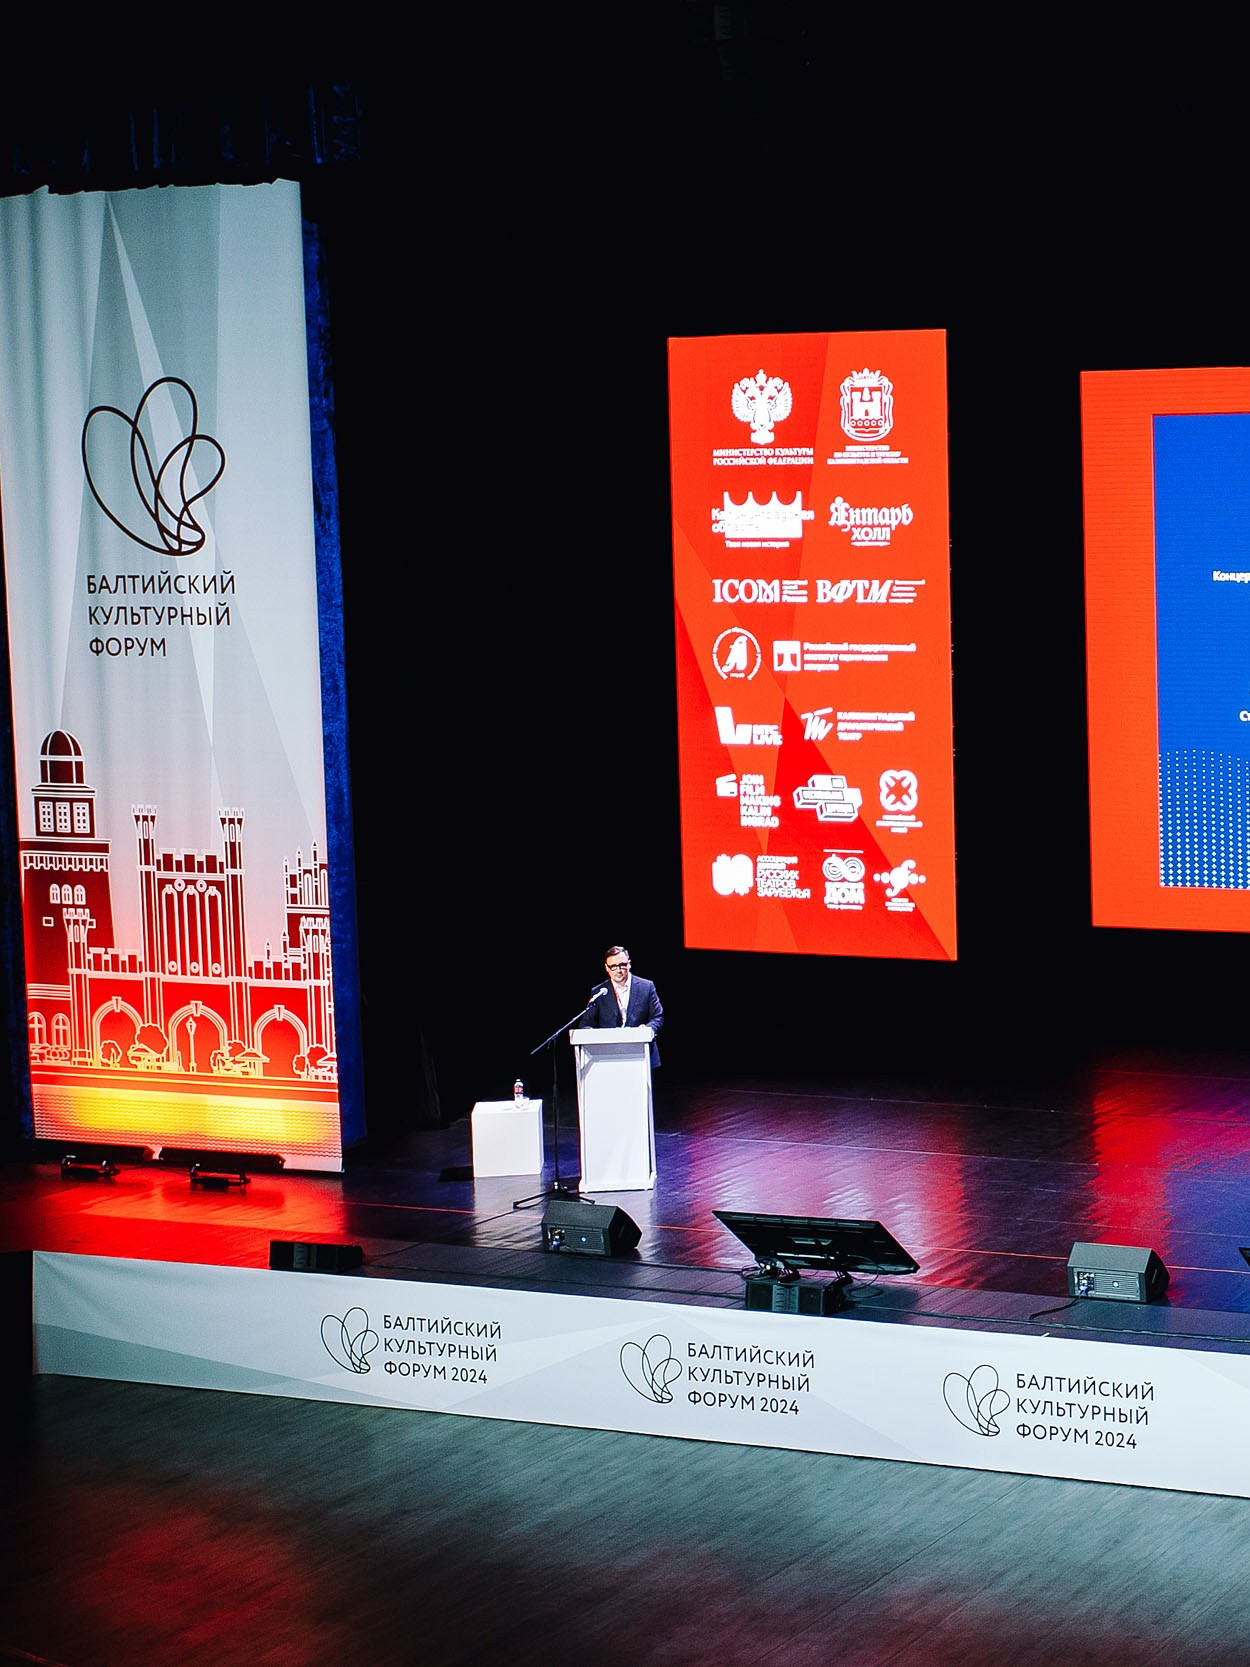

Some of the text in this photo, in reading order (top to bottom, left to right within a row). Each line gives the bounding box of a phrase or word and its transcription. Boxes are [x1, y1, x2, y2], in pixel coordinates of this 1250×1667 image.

[851, 527, 890, 541] ХОЛЛ
[87, 570, 236, 595] БАЛТИЙСКИЙ
[712, 579, 780, 603] ICOM
[88, 602, 231, 626] КУЛЬТУРНЫЙ
[89, 637, 166, 658] ФОРУМ
[756, 878, 796, 889] ТЕАТРОВ
[383, 1314, 502, 1340] БАЛТИЙСКИЙ
[383, 1337, 498, 1362] КУЛЬТУРНЫЙ
[687, 1342, 815, 1369] БАЛТИЙСКИЙ
[384, 1361, 488, 1384] ФОРУМ 2024
[687, 1365, 810, 1393] КУЛЬТУРНЫЙ
[1016, 1373, 1155, 1401] БАЛТИЙСКИЙ
[687, 1390, 799, 1415] ФОРУМ 2024
[1016, 1398, 1149, 1426] КУЛЬТУРНЫЙ
[1016, 1423, 1137, 1449] ФОРУМ 2024
